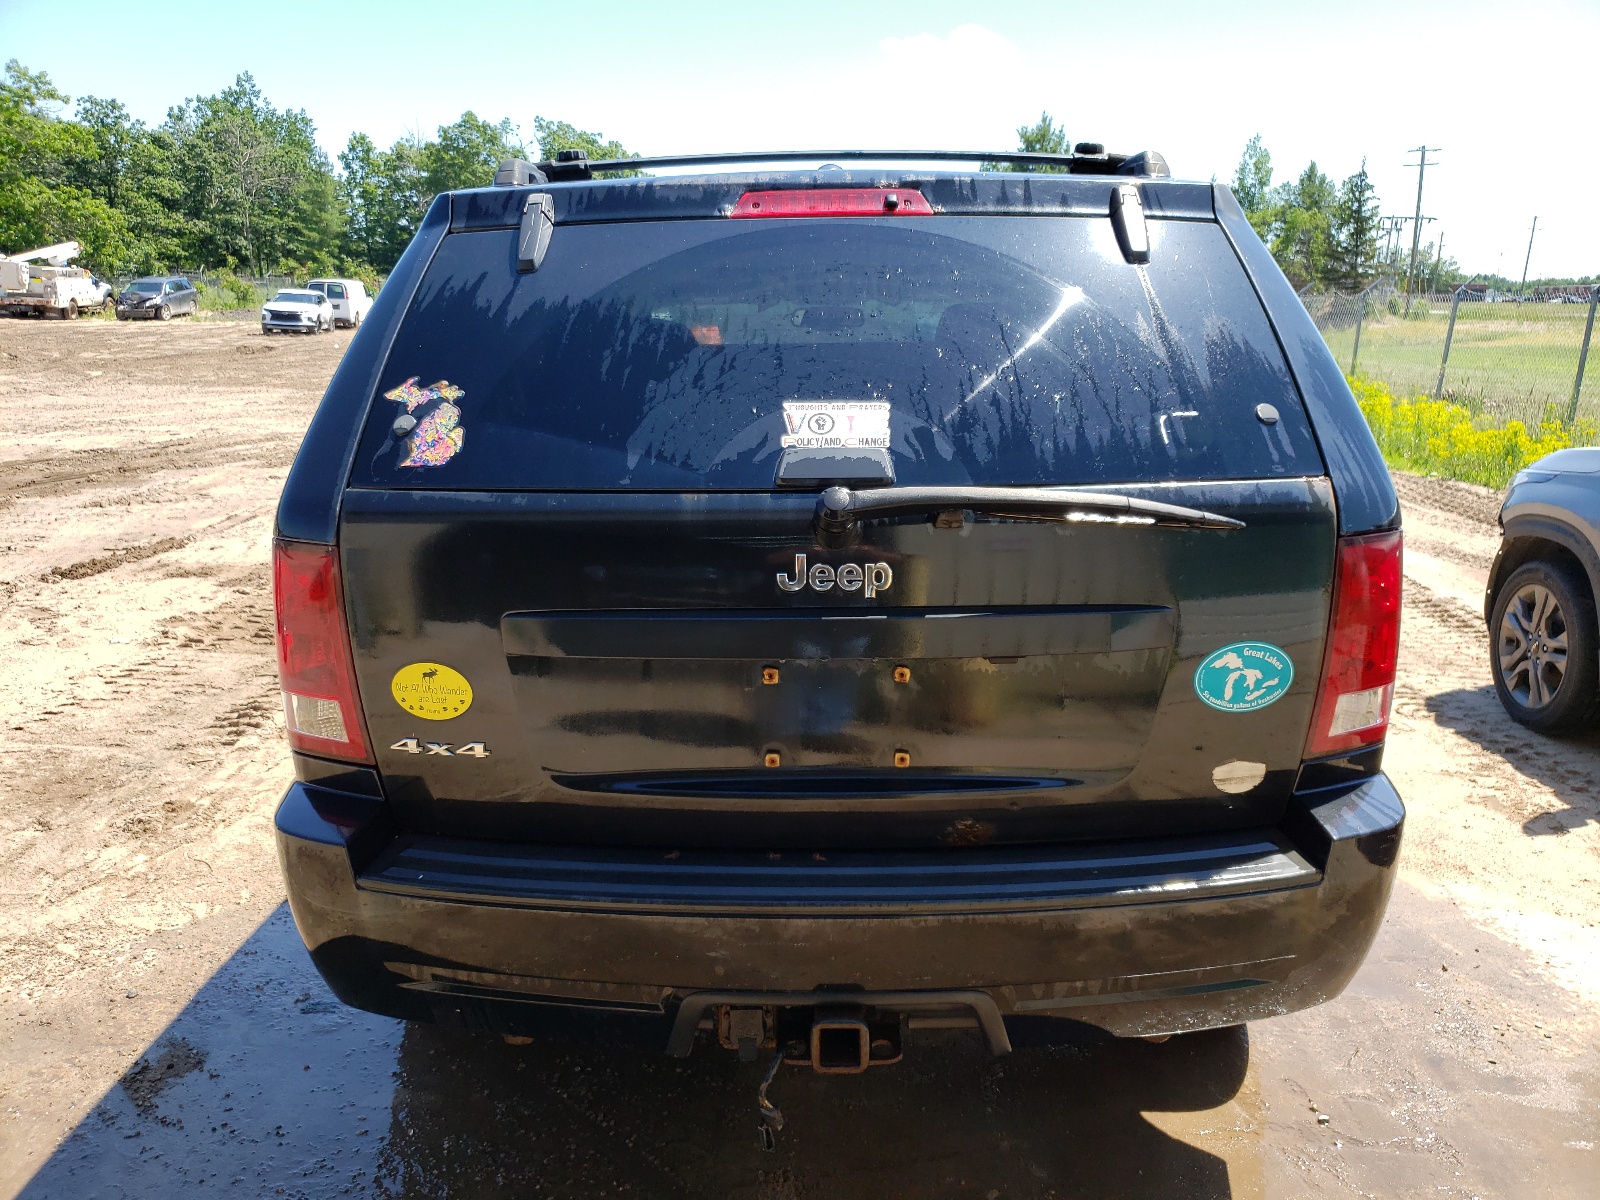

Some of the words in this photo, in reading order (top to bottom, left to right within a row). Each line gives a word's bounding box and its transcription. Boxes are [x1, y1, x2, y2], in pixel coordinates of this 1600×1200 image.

[844, 437, 888, 447] CHANGE
[776, 553, 893, 599] Jeep
[1243, 647, 1264, 659] Great
[1264, 652, 1283, 670] Lakes
[395, 682, 409, 693] Not
[440, 684, 468, 696] Wander
[390, 737, 492, 758] 4x4
